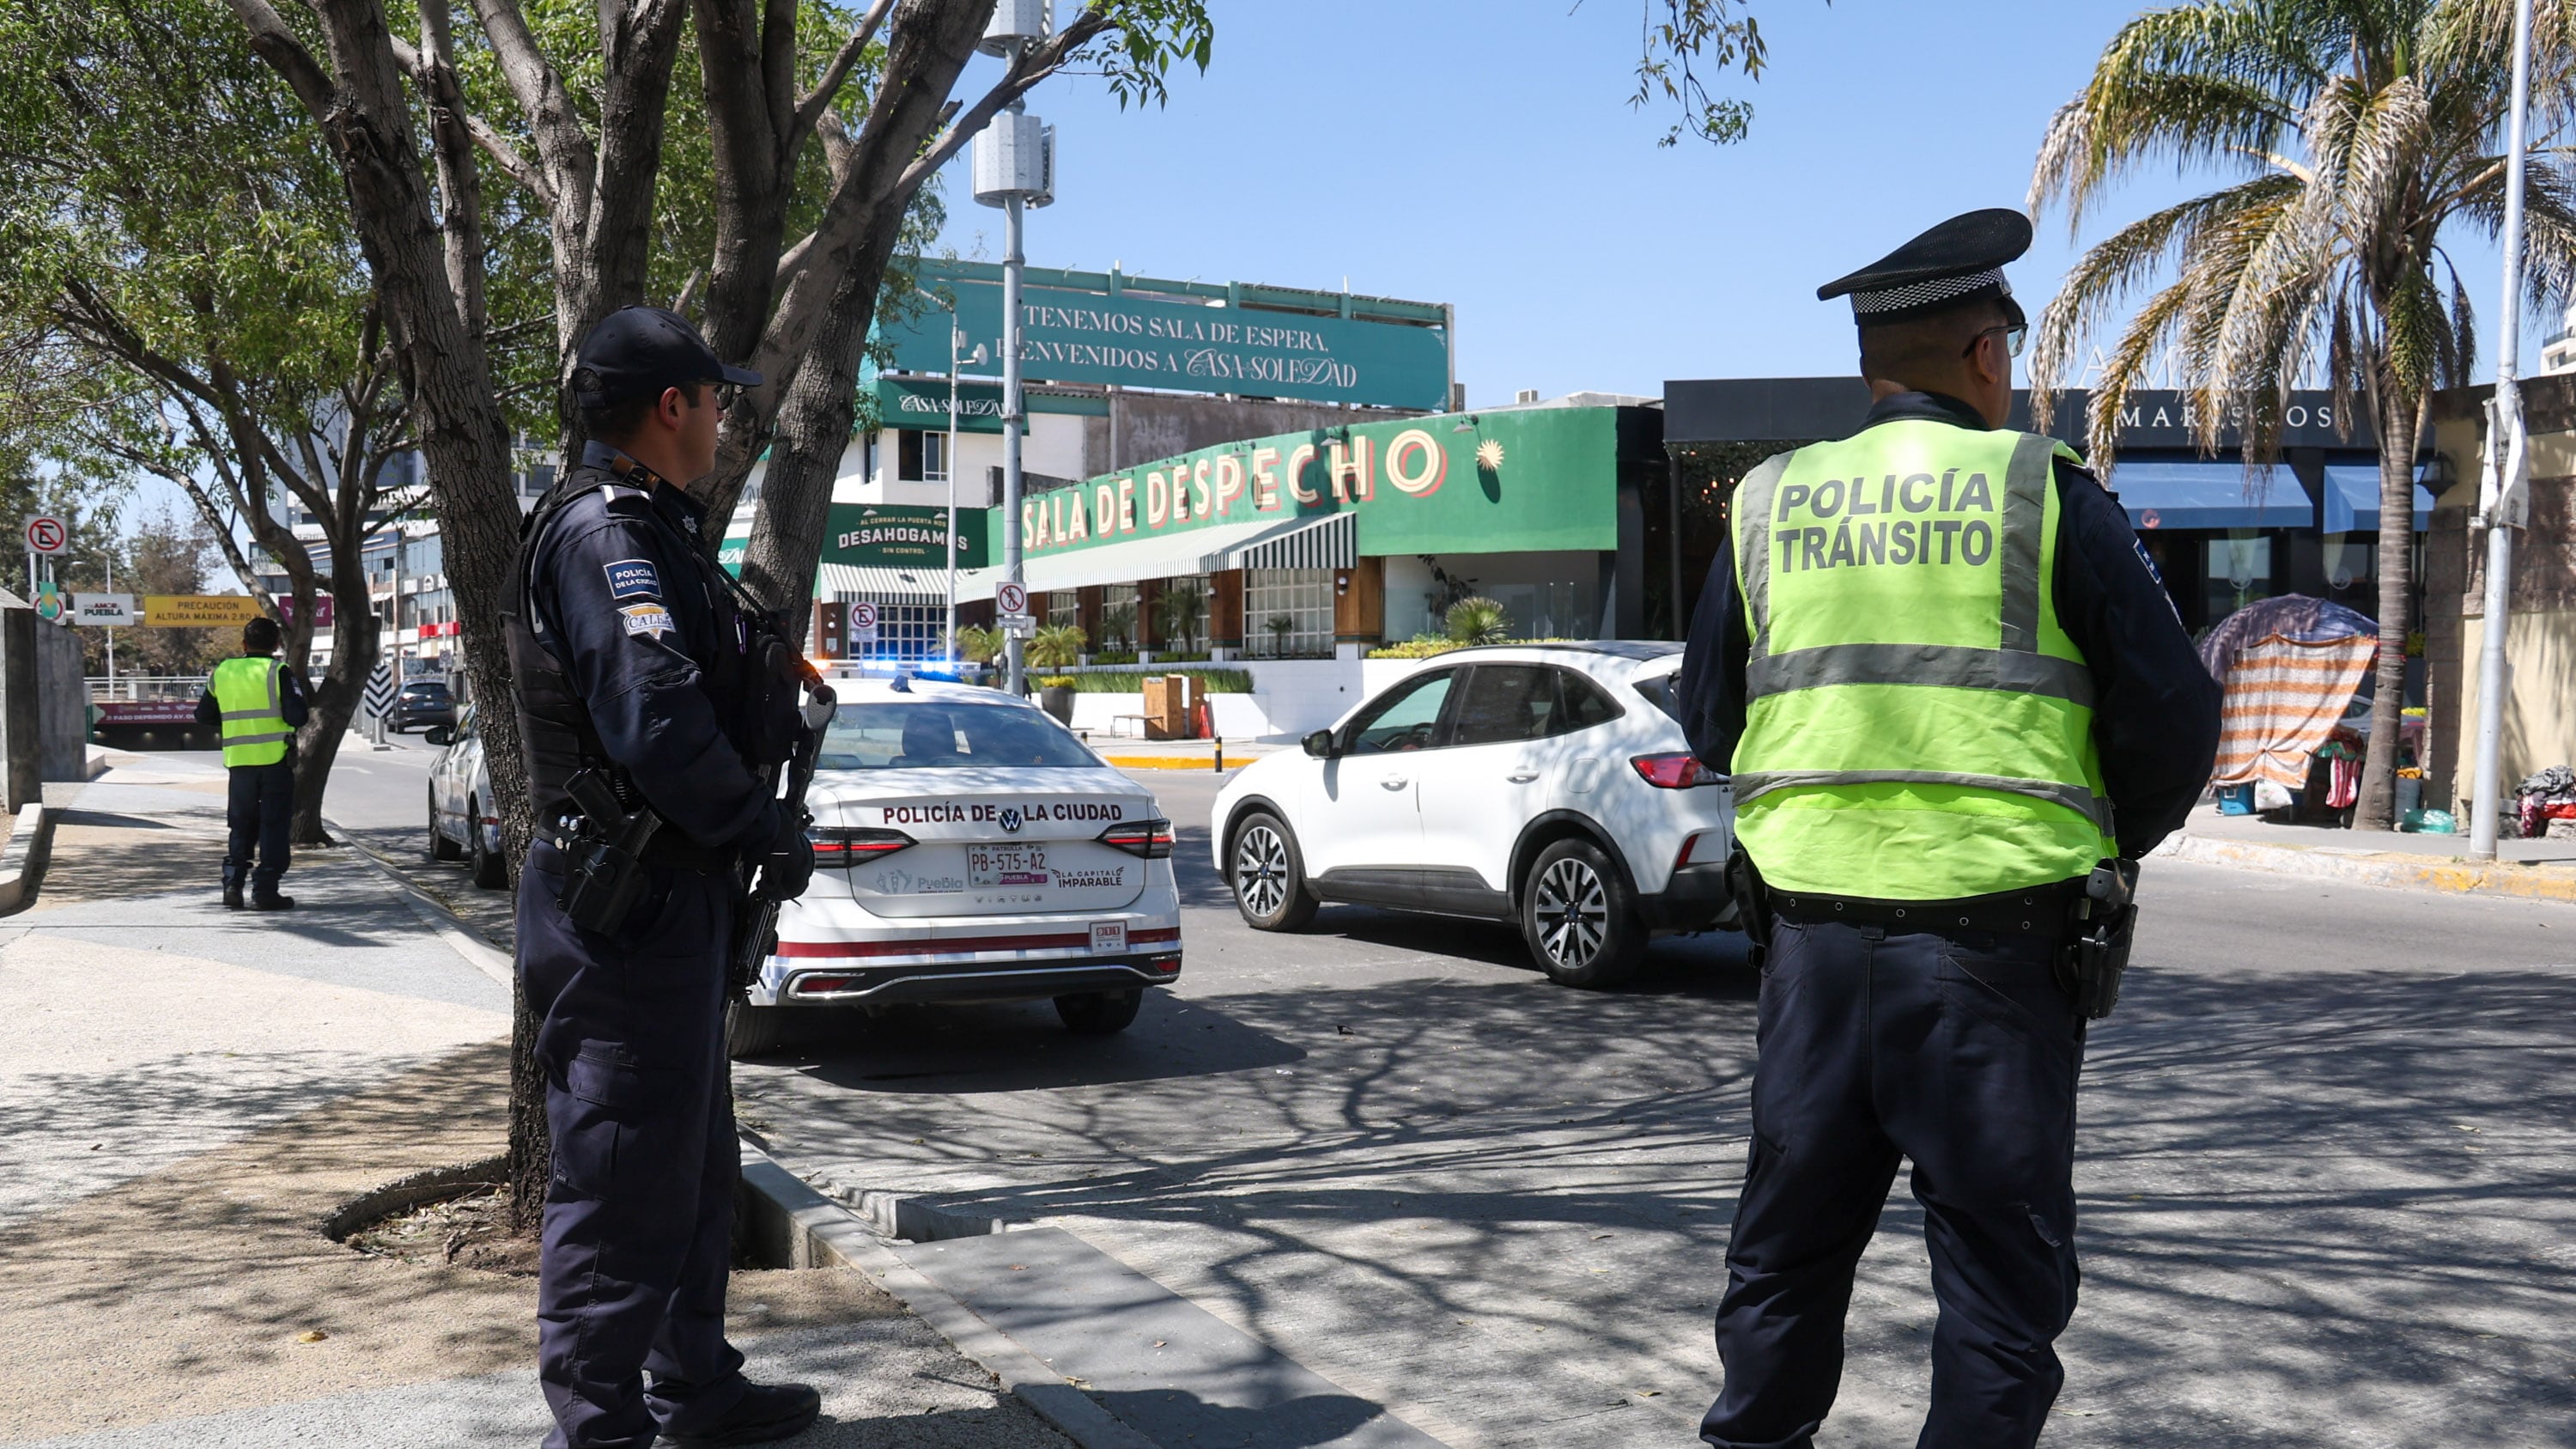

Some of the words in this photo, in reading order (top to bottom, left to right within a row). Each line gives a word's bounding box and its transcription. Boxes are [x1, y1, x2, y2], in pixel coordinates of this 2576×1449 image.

[1024, 305, 1143, 335] TENEMOS
[1149, 318, 1205, 341] SALA
[1211, 323, 1240, 344] DE
[1246, 326, 1329, 353] ESPERA,
[1163, 352, 1178, 372] A
[1184, 349, 1244, 379] CASA
[1250, 356, 1357, 387] SOLEDAD
[898, 394, 939, 413] CASA
[1023, 491, 1090, 553] SALA
[1097, 478, 1138, 536] DE
[1147, 429, 1448, 529] DESPECHO
[1777, 467, 1994, 522] POLICÍA
[1776, 516, 1993, 573] TRÁNSITO
[615, 567, 653, 580] POLICÍA
[178, 600, 240, 611] PRECAUCIÓN
[883, 801, 966, 825] POLICÍA
[971, 804, 997, 822] DE
[1024, 804, 1048, 821] LA
[1053, 804, 1122, 821] CIUDAD
[972, 852, 1047, 872] PB-575-A2
[918, 877, 963, 889] Puebla
[1058, 877, 1123, 888] IMPARABLE
